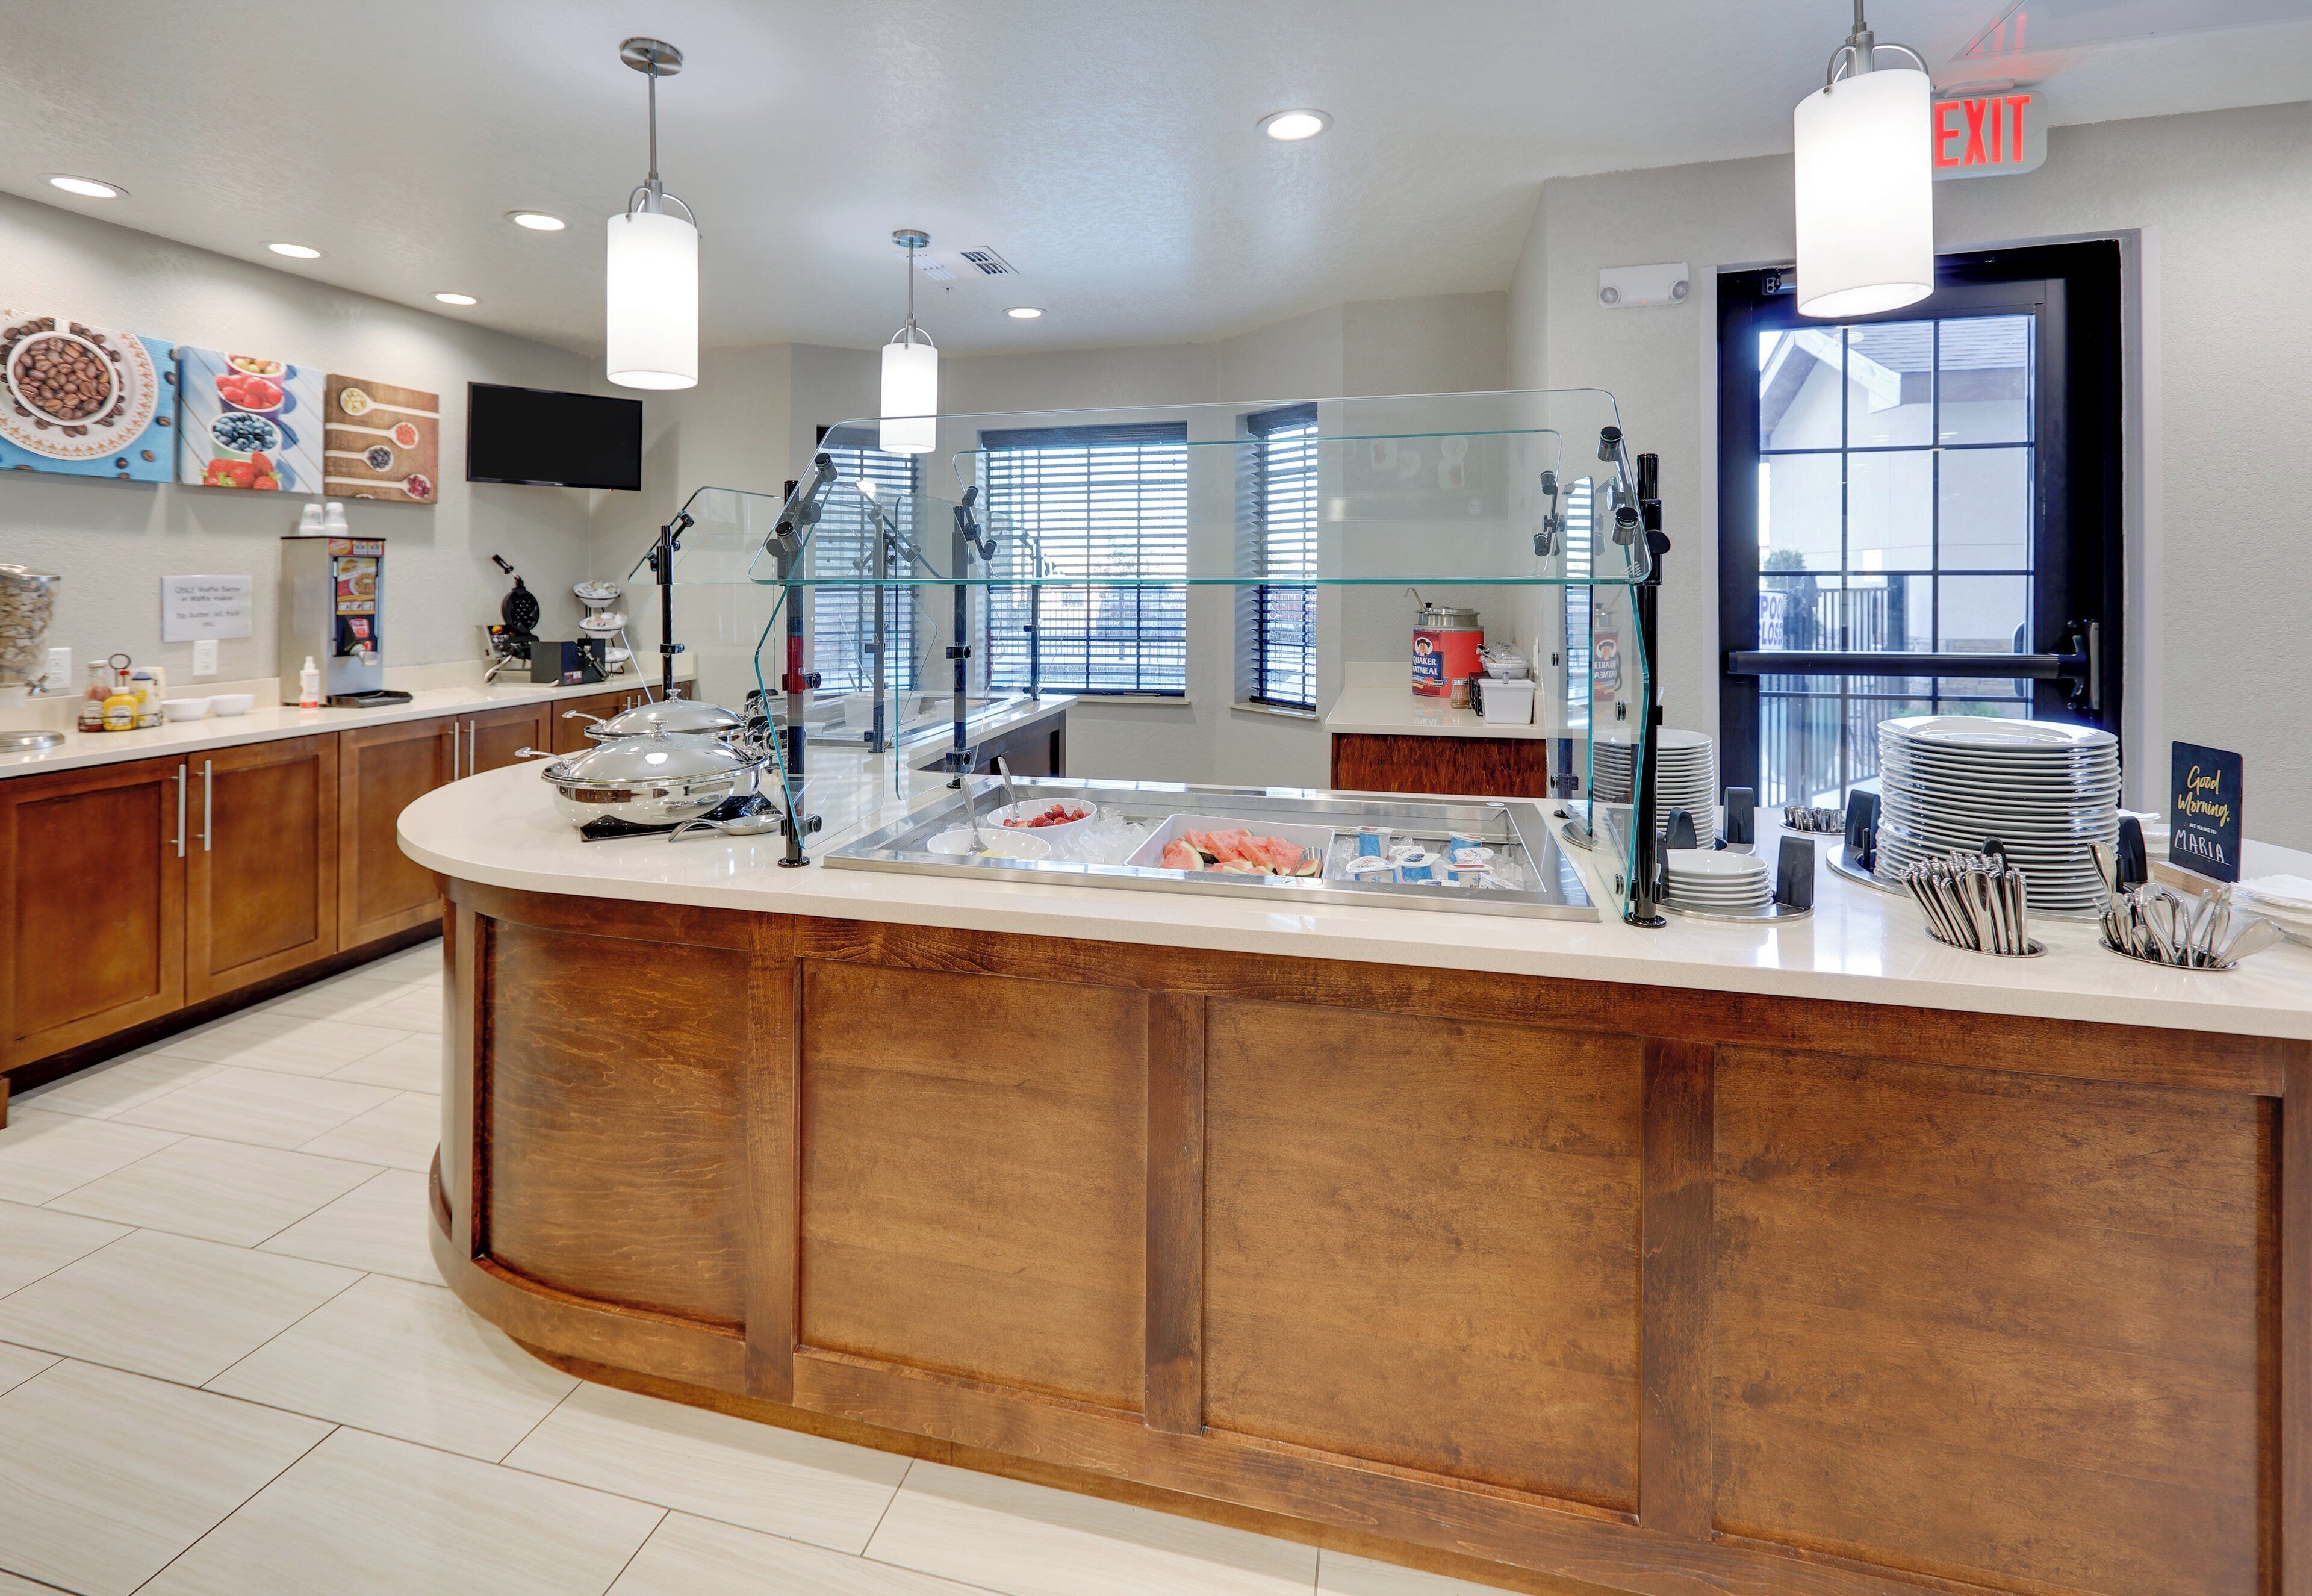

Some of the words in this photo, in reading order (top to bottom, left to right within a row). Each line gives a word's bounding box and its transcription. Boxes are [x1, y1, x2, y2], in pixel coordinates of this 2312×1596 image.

[1934, 95, 2031, 169] EXIT
[2186, 765, 2222, 796] Good
[2196, 824, 2210, 833] NAME
[2174, 828, 2225, 863] MARIA
